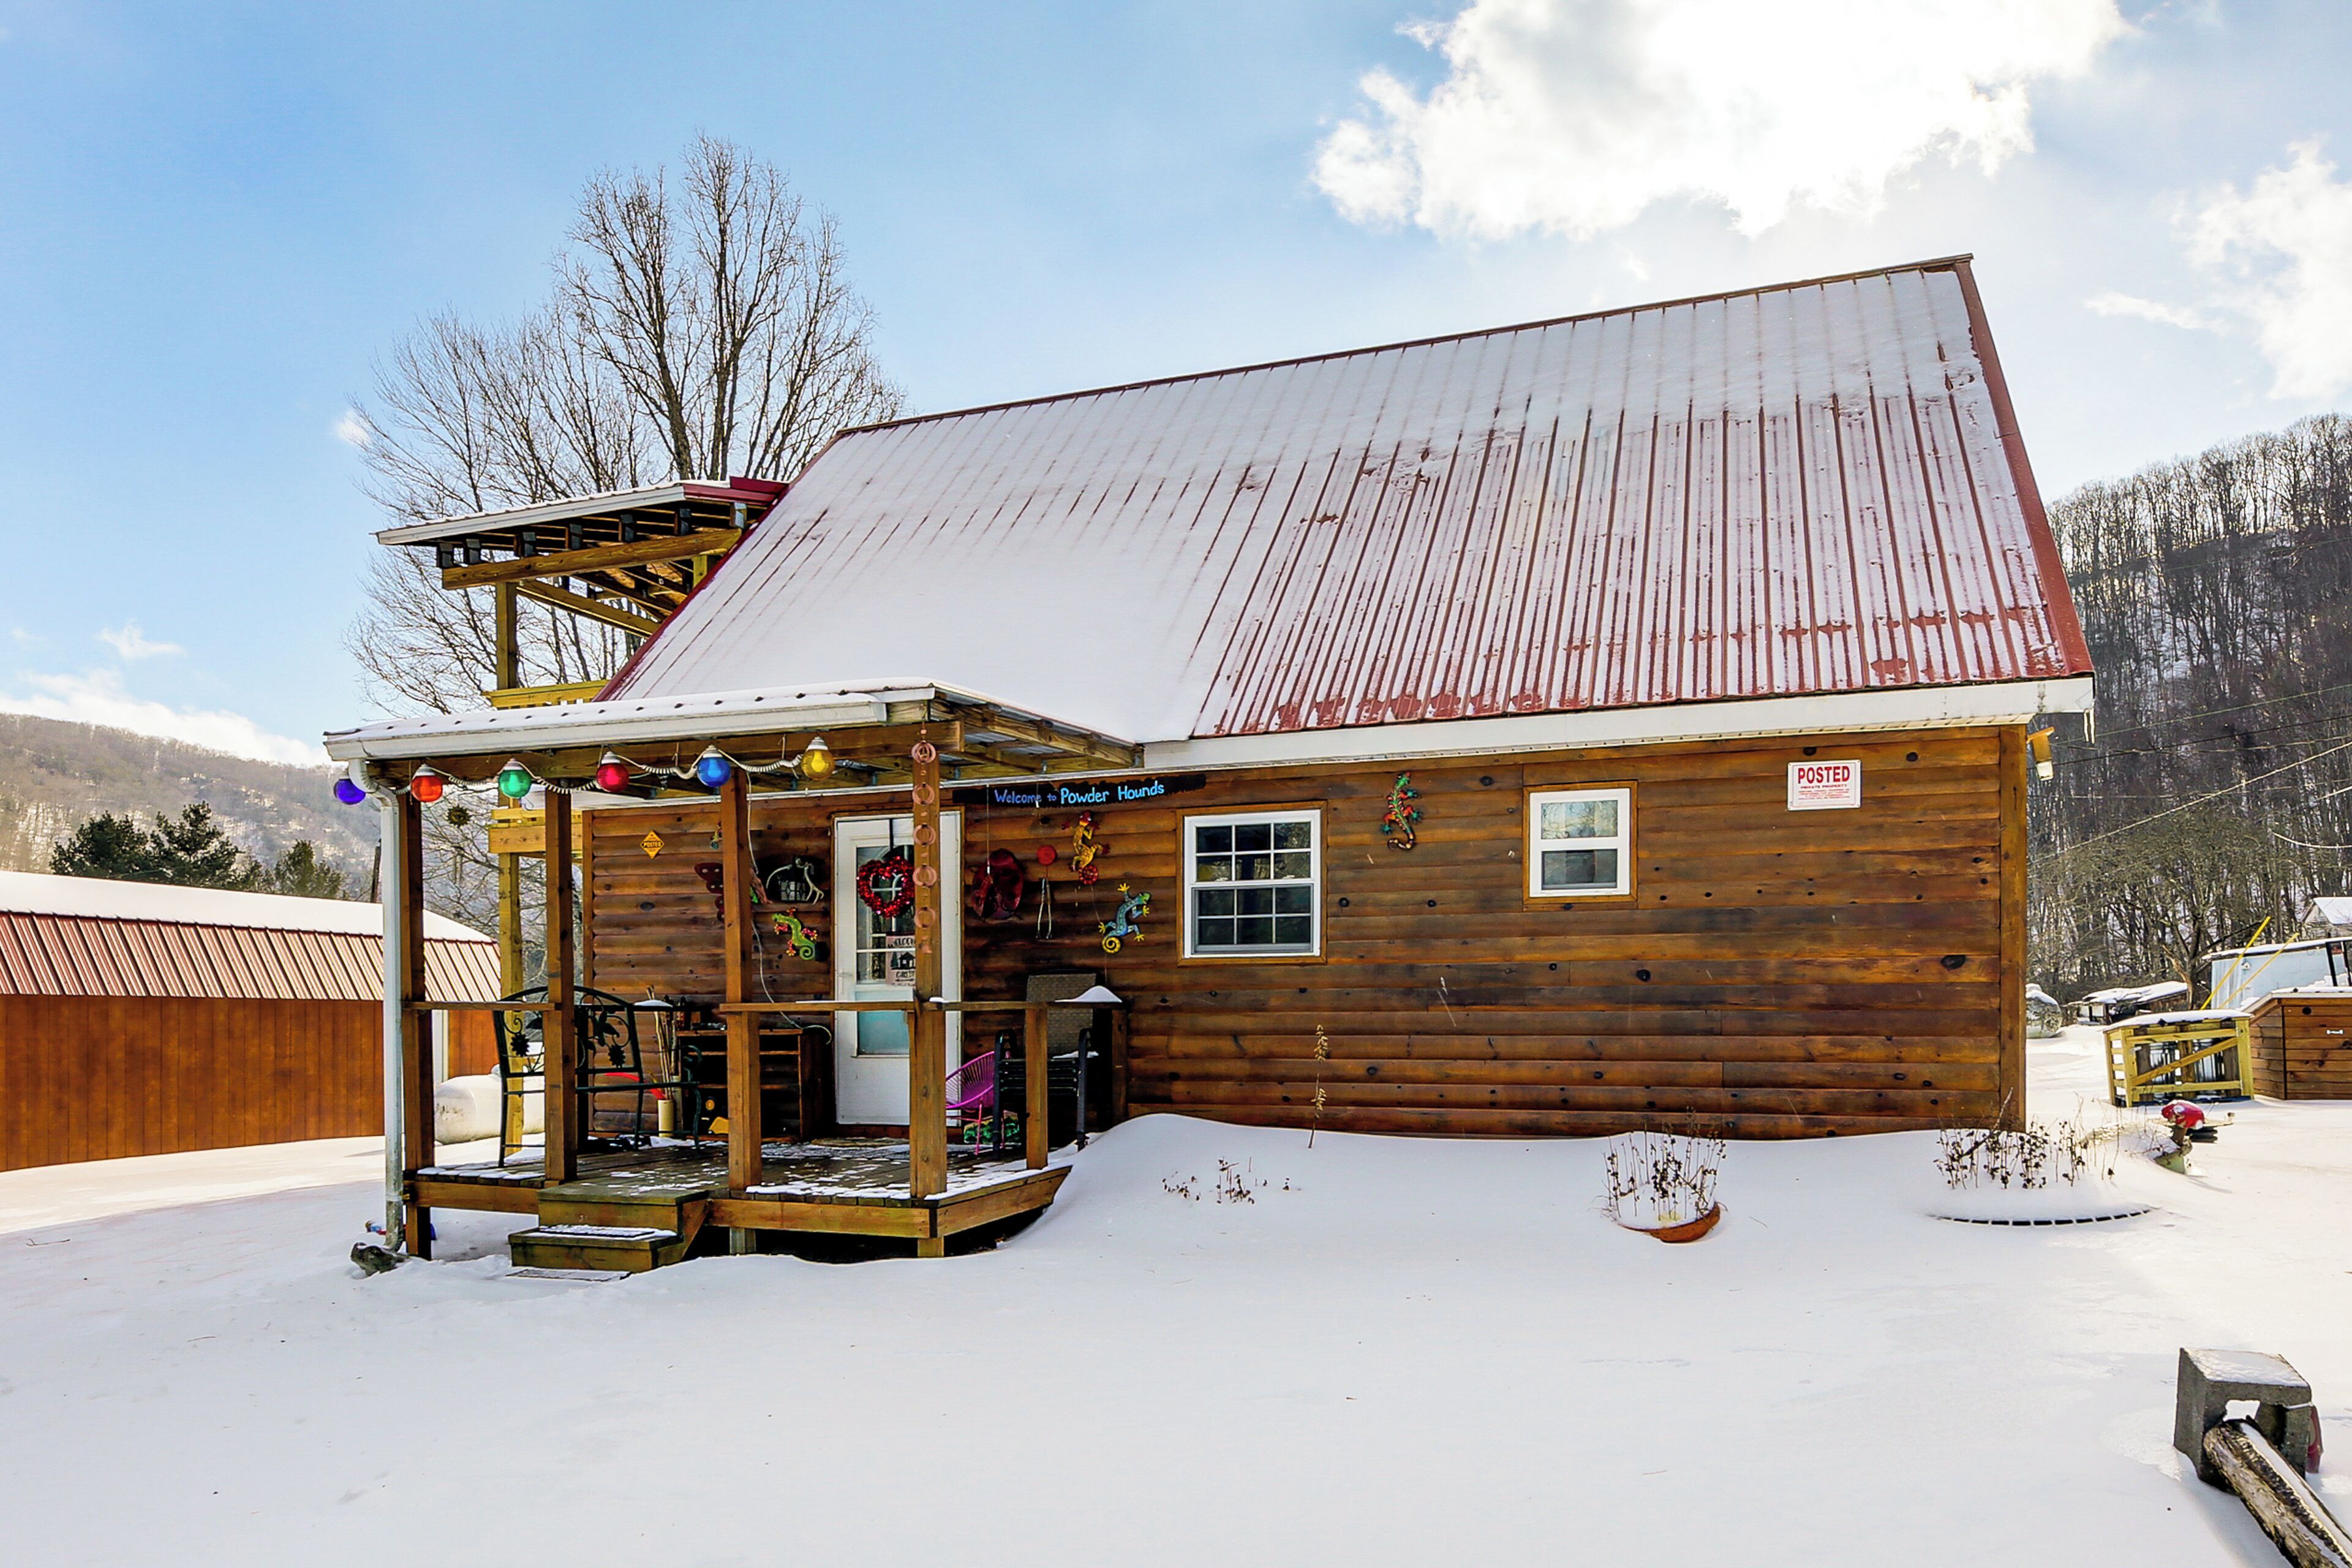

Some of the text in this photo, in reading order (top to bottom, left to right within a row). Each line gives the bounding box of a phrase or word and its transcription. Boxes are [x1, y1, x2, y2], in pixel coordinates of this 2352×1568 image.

[1798, 766, 1850, 784] POSTED
[994, 780, 1165, 805] Welcome to Powder Hounds
